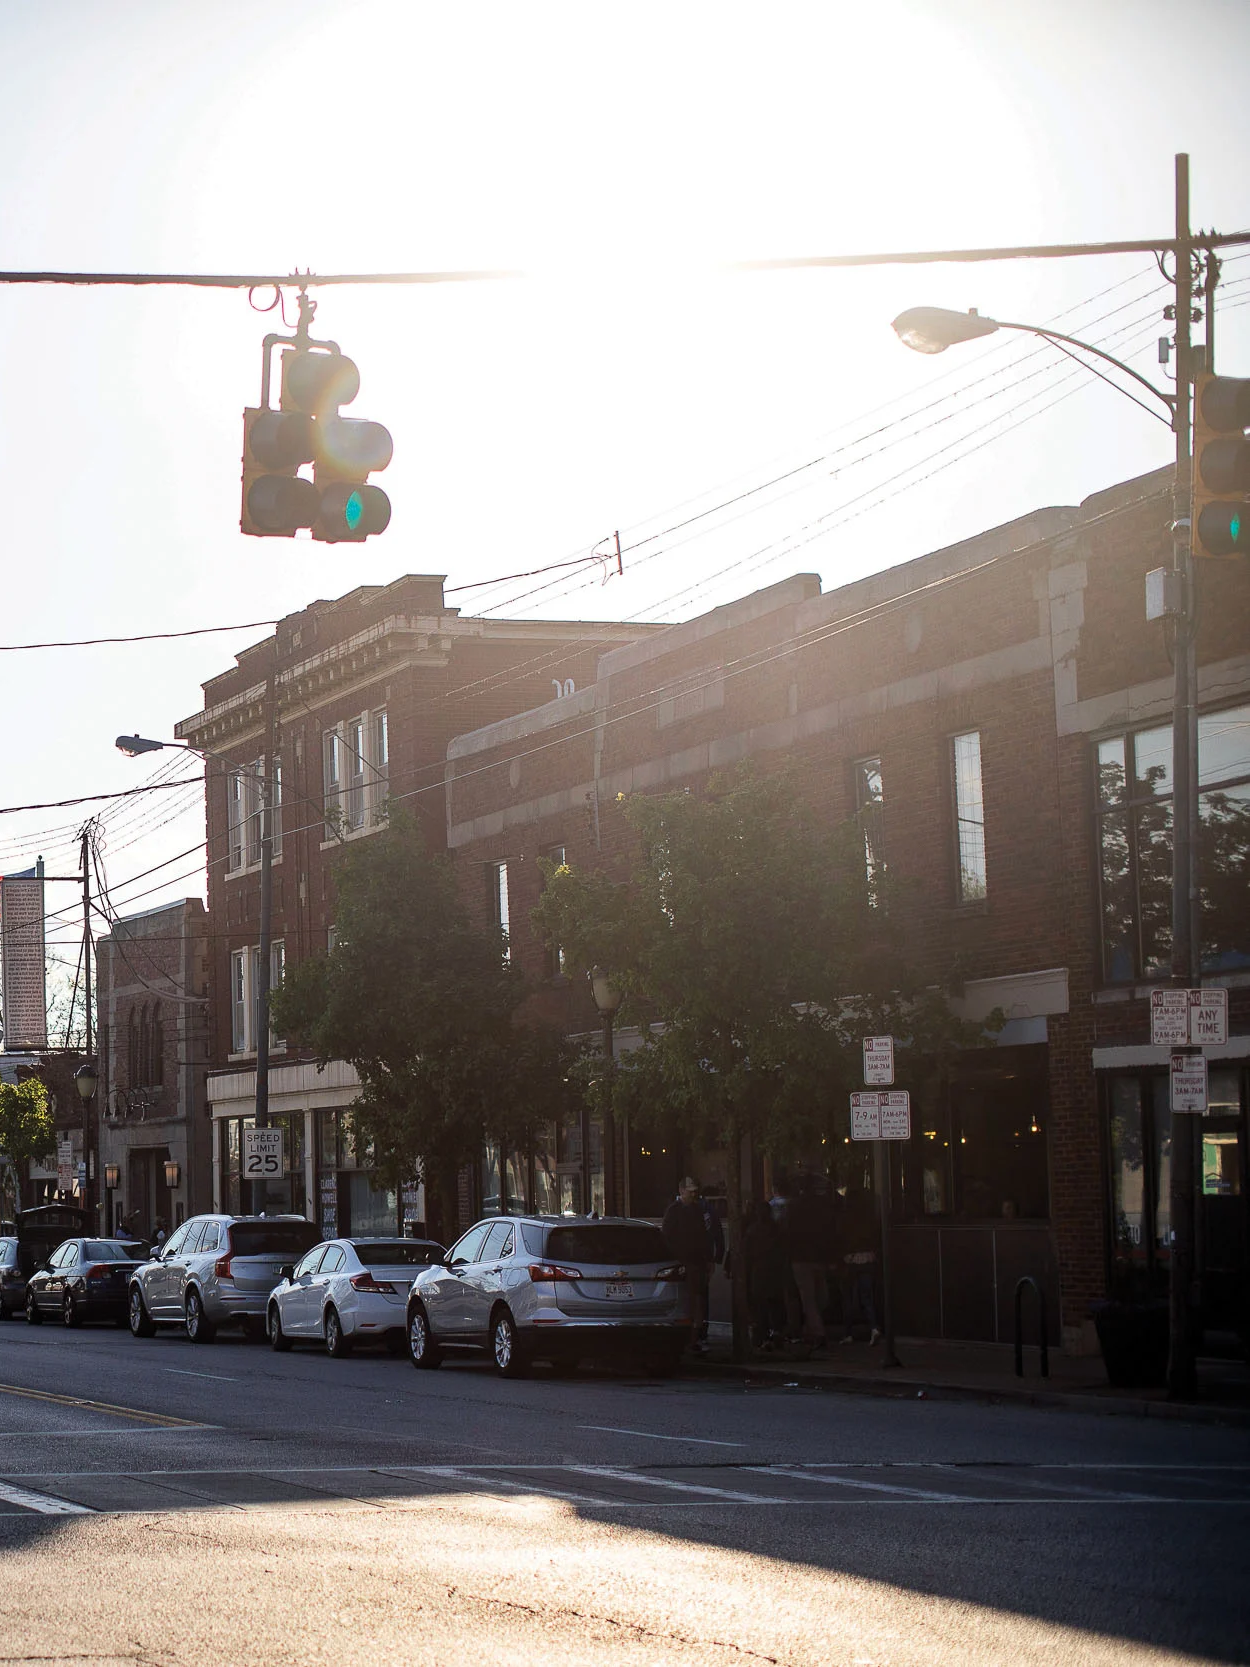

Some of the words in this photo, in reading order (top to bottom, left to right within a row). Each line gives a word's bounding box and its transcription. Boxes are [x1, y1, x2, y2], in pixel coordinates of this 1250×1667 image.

[1153, 993, 1163, 1005] NO
[1191, 993, 1201, 1004] NO
[1198, 1010, 1217, 1020] ANY
[1197, 1023, 1220, 1034] TIME
[1155, 1031, 1186, 1039] 9AM-6PM
[864, 1040, 873, 1050] NO
[1172, 1059, 1183, 1070] NO
[1174, 1087, 1204, 1095] 3AM-7AM
[852, 1095, 860, 1105] NO
[881, 1095, 889, 1104] NO
[855, 1112, 868, 1120] 7-9
[247, 1134, 280, 1142] SPEED
[250, 1144, 276, 1152] LIMIT
[248, 1154, 279, 1173] 25
